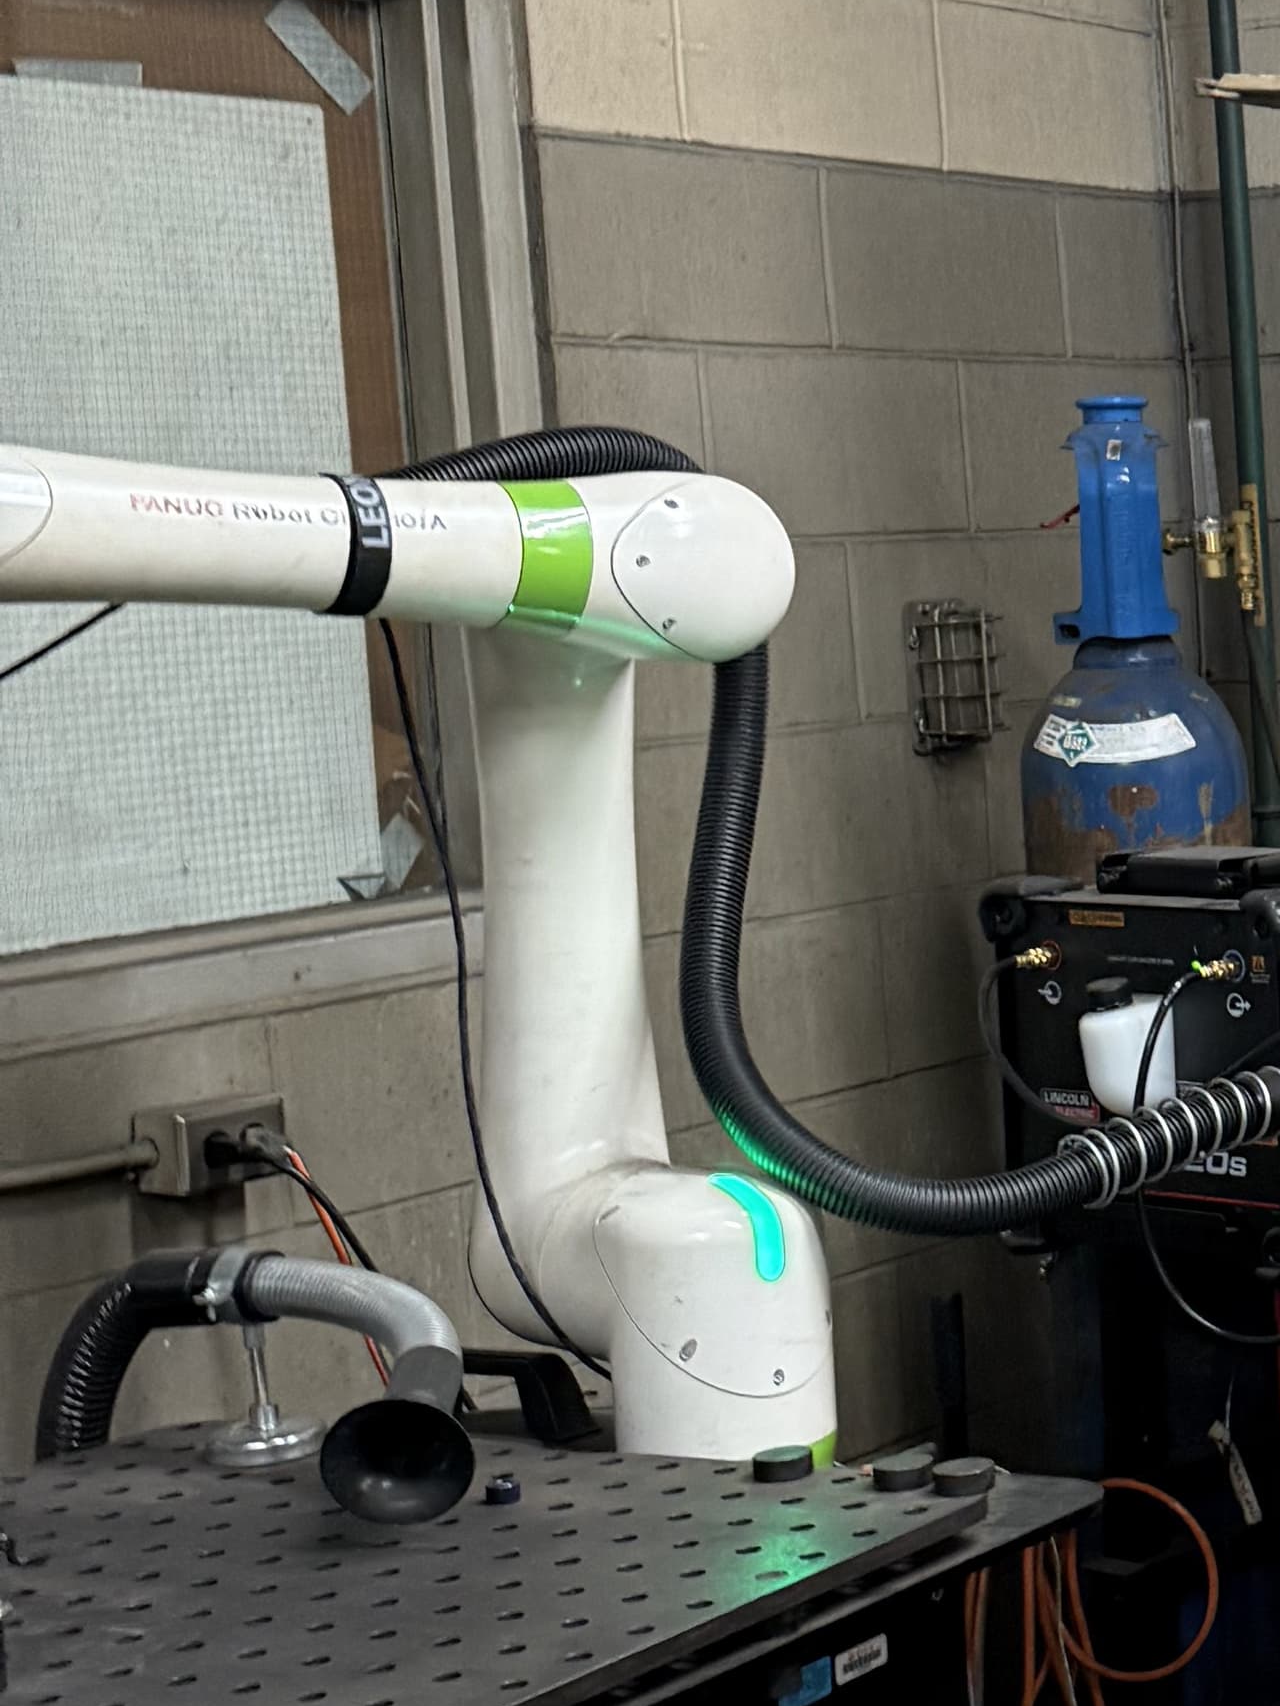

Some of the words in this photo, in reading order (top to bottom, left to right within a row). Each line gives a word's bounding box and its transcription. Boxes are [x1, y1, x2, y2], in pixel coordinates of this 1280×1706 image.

[130, 493, 223, 517] FANUC
[233, 500, 312, 525] Robot
[1045, 1090, 1090, 1106] LINCOLN
